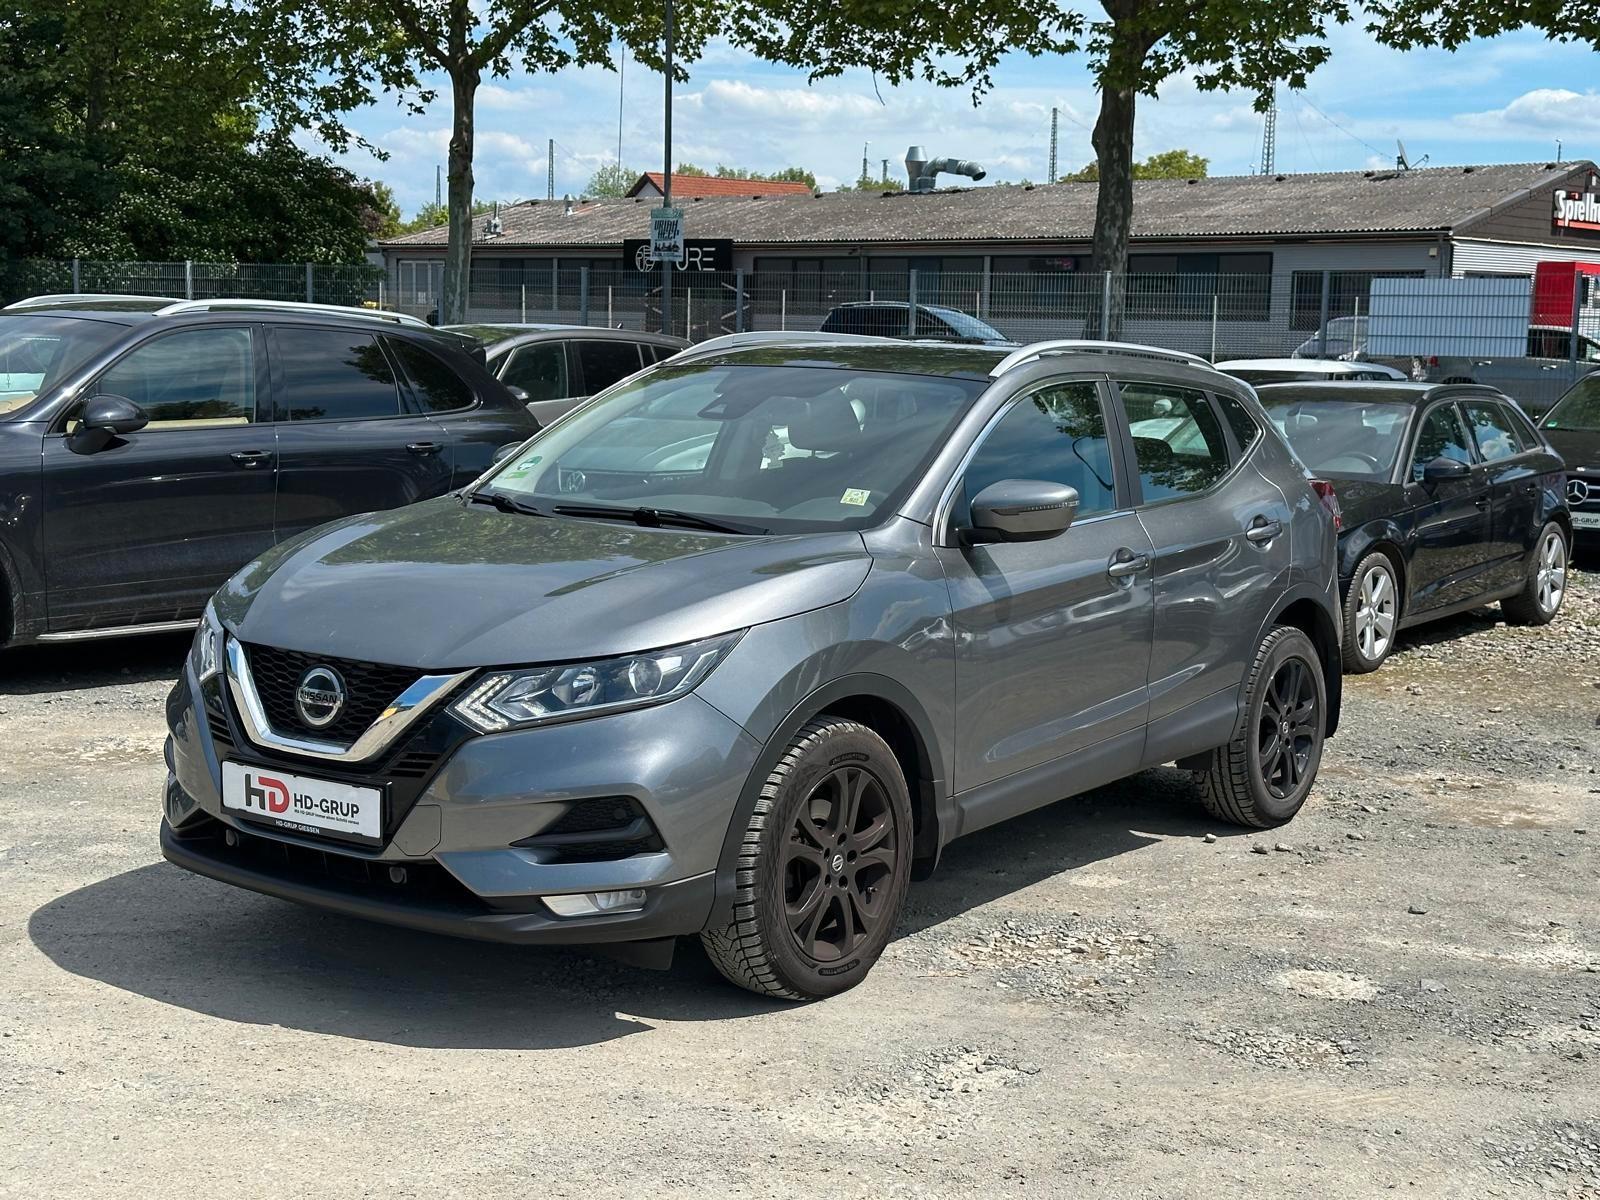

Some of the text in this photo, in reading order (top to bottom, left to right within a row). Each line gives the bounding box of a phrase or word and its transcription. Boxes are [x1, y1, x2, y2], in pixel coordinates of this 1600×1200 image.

[676, 248, 716, 271] URE
[300, 690, 337, 704] NISSAN
[244, 773, 290, 814] HD
[294, 793, 360, 818] HD-GRUP
